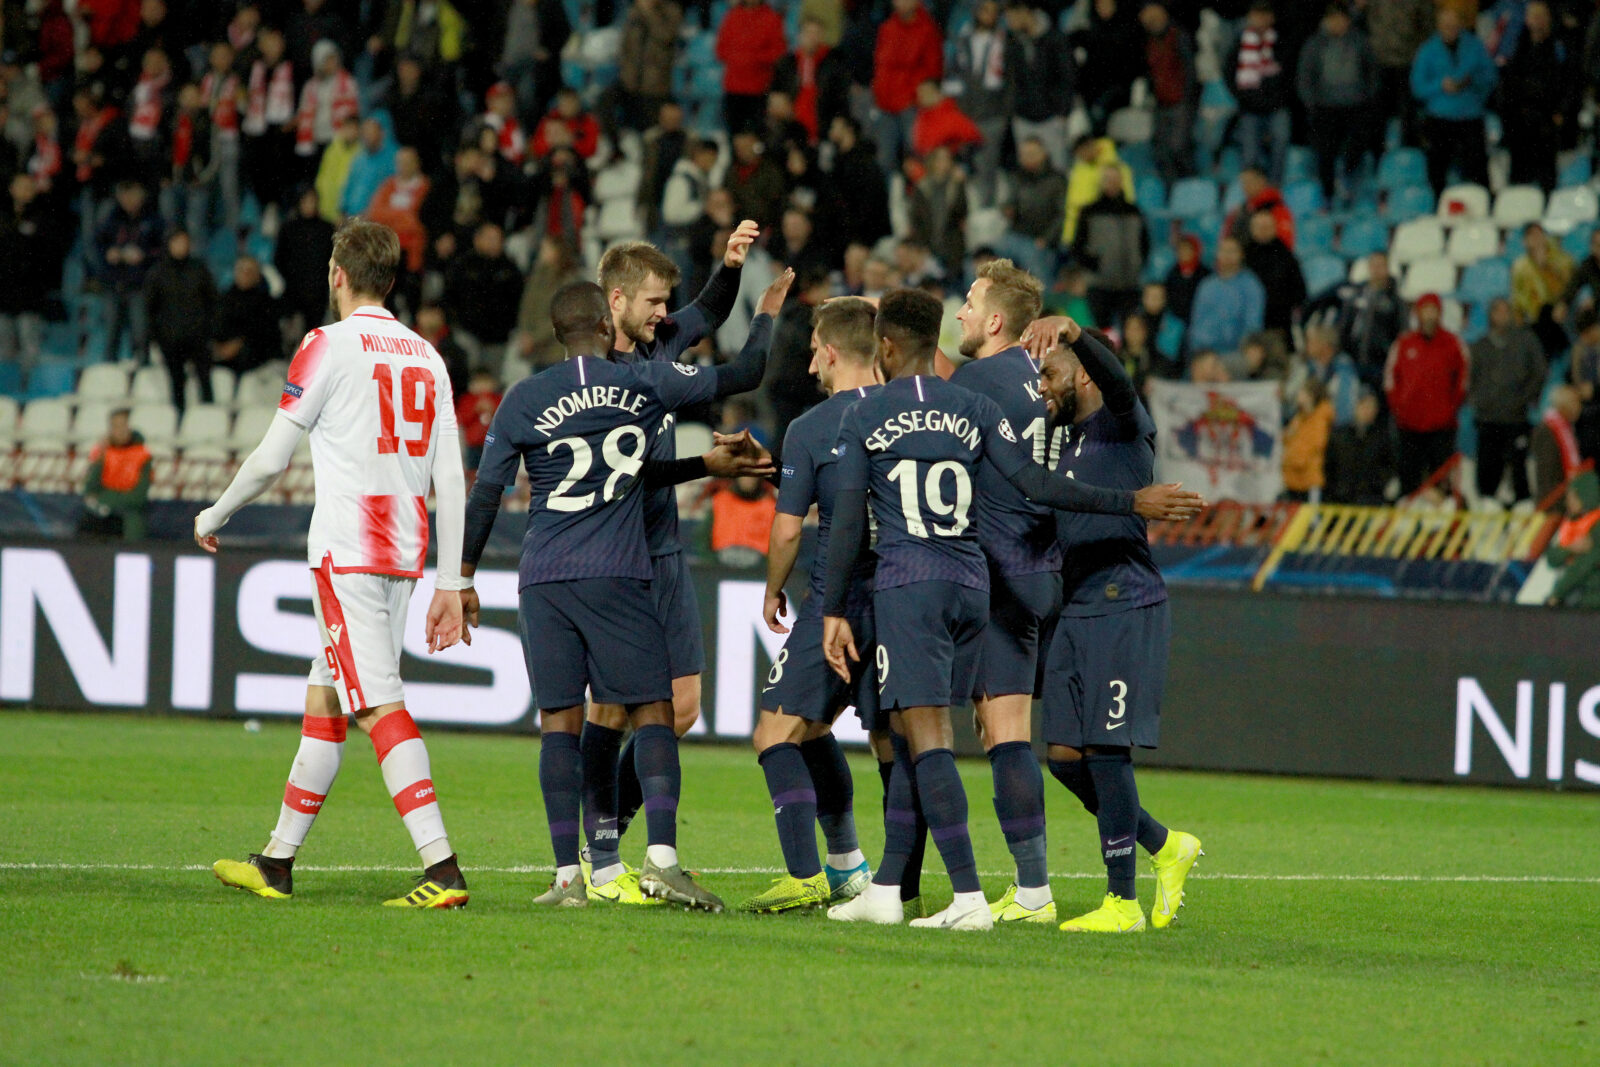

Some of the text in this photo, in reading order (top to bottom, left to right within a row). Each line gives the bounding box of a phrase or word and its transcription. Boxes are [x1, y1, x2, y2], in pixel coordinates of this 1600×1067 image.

[284, 384, 303, 396] ESPECT
[372, 363, 436, 457] 19
[534, 385, 647, 437] NDOMBELE
[865, 409, 982, 452] SESSEGNON
[547, 424, 646, 511] 28
[886, 459, 972, 538] 19
[0, 547, 870, 744] NISSN
[768, 648, 788, 684] 8
[876, 644, 889, 684] 9
[1108, 679, 1128, 719] 3
[594, 828, 619, 841] SPUR
[1105, 846, 1133, 858] SPURS
